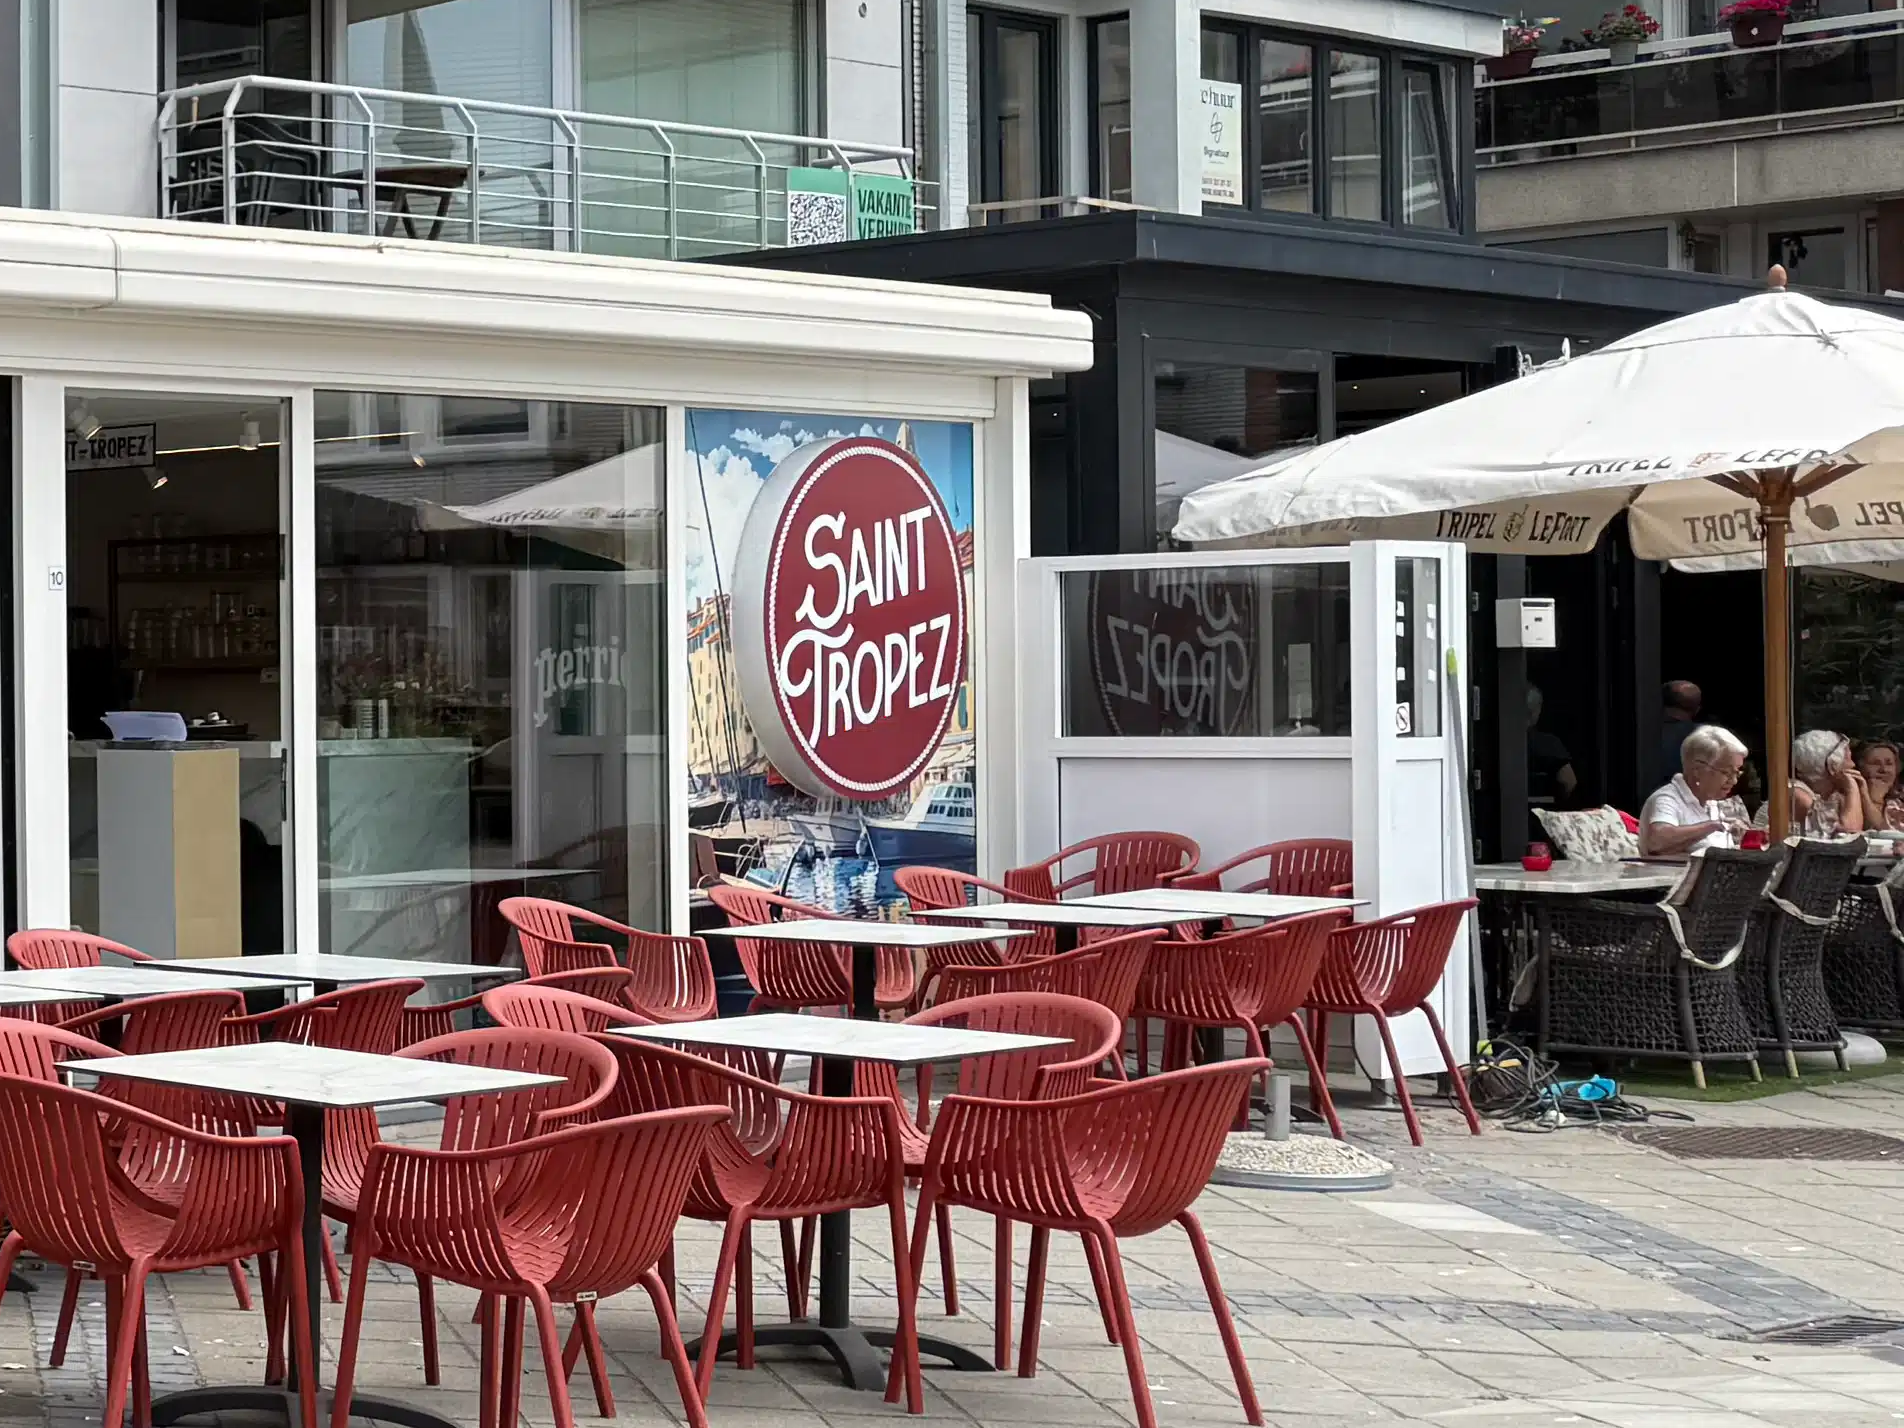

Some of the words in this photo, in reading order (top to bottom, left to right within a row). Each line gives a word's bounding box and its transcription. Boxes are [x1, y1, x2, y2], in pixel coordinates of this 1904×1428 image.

[795, 505, 933, 628] SAINT
[1436, 510, 1497, 539] TRIPEL
[50, 570, 64, 586] 10
[533, 636, 627, 729] perri
[780, 613, 953, 749] TROPEZ
